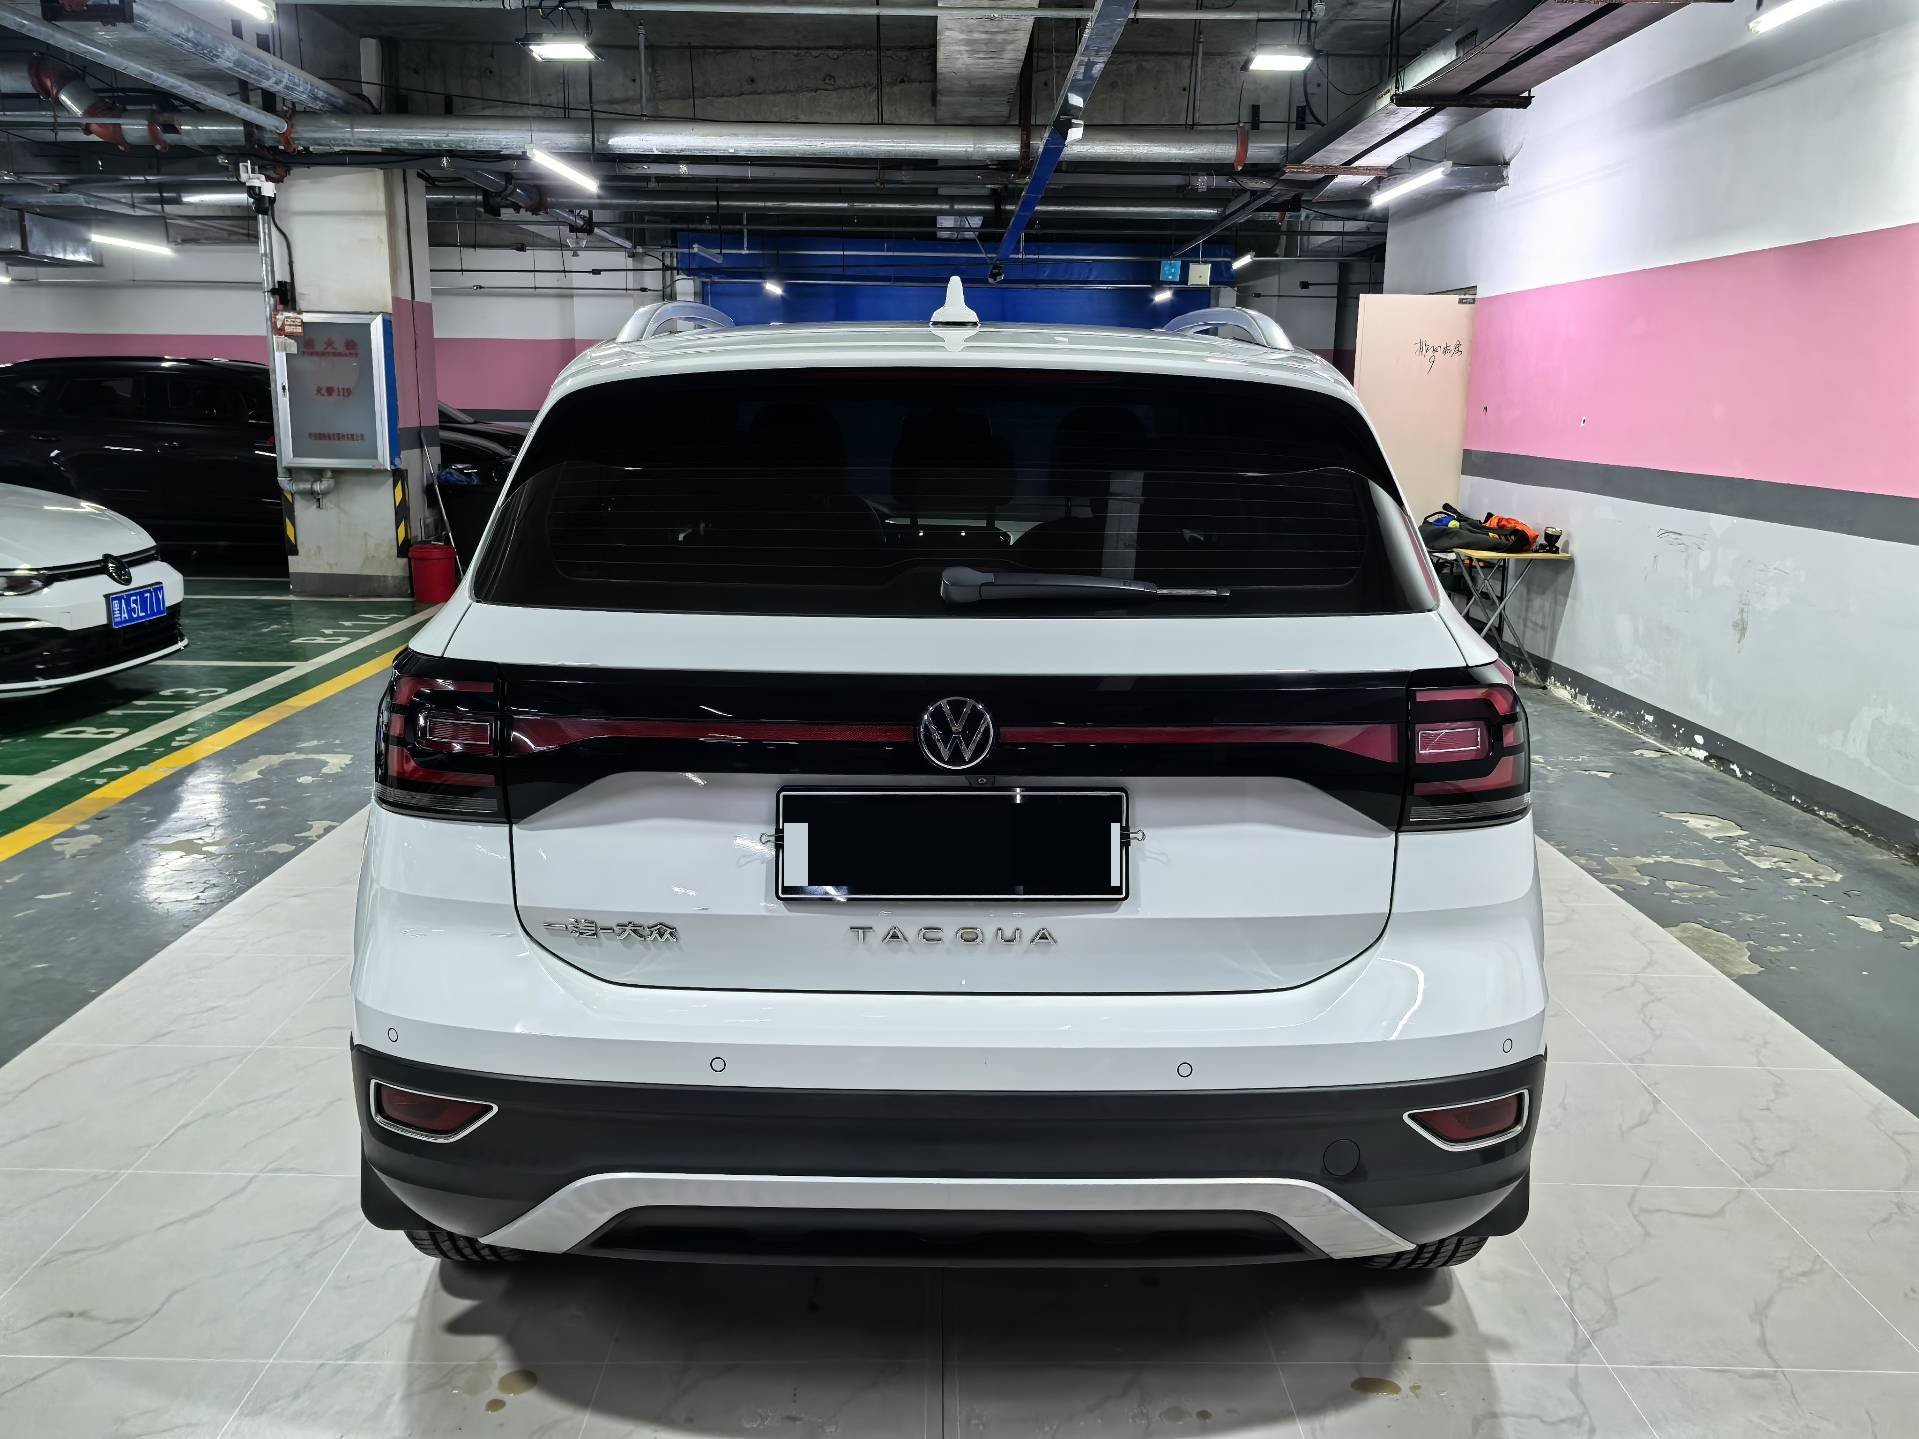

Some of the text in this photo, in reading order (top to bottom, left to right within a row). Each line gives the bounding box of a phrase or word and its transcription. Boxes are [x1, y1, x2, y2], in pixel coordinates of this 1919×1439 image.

[289, 614, 407, 644] B114
[40, 687, 228, 739] B113
[849, 926, 1058, 945] TACQUA
